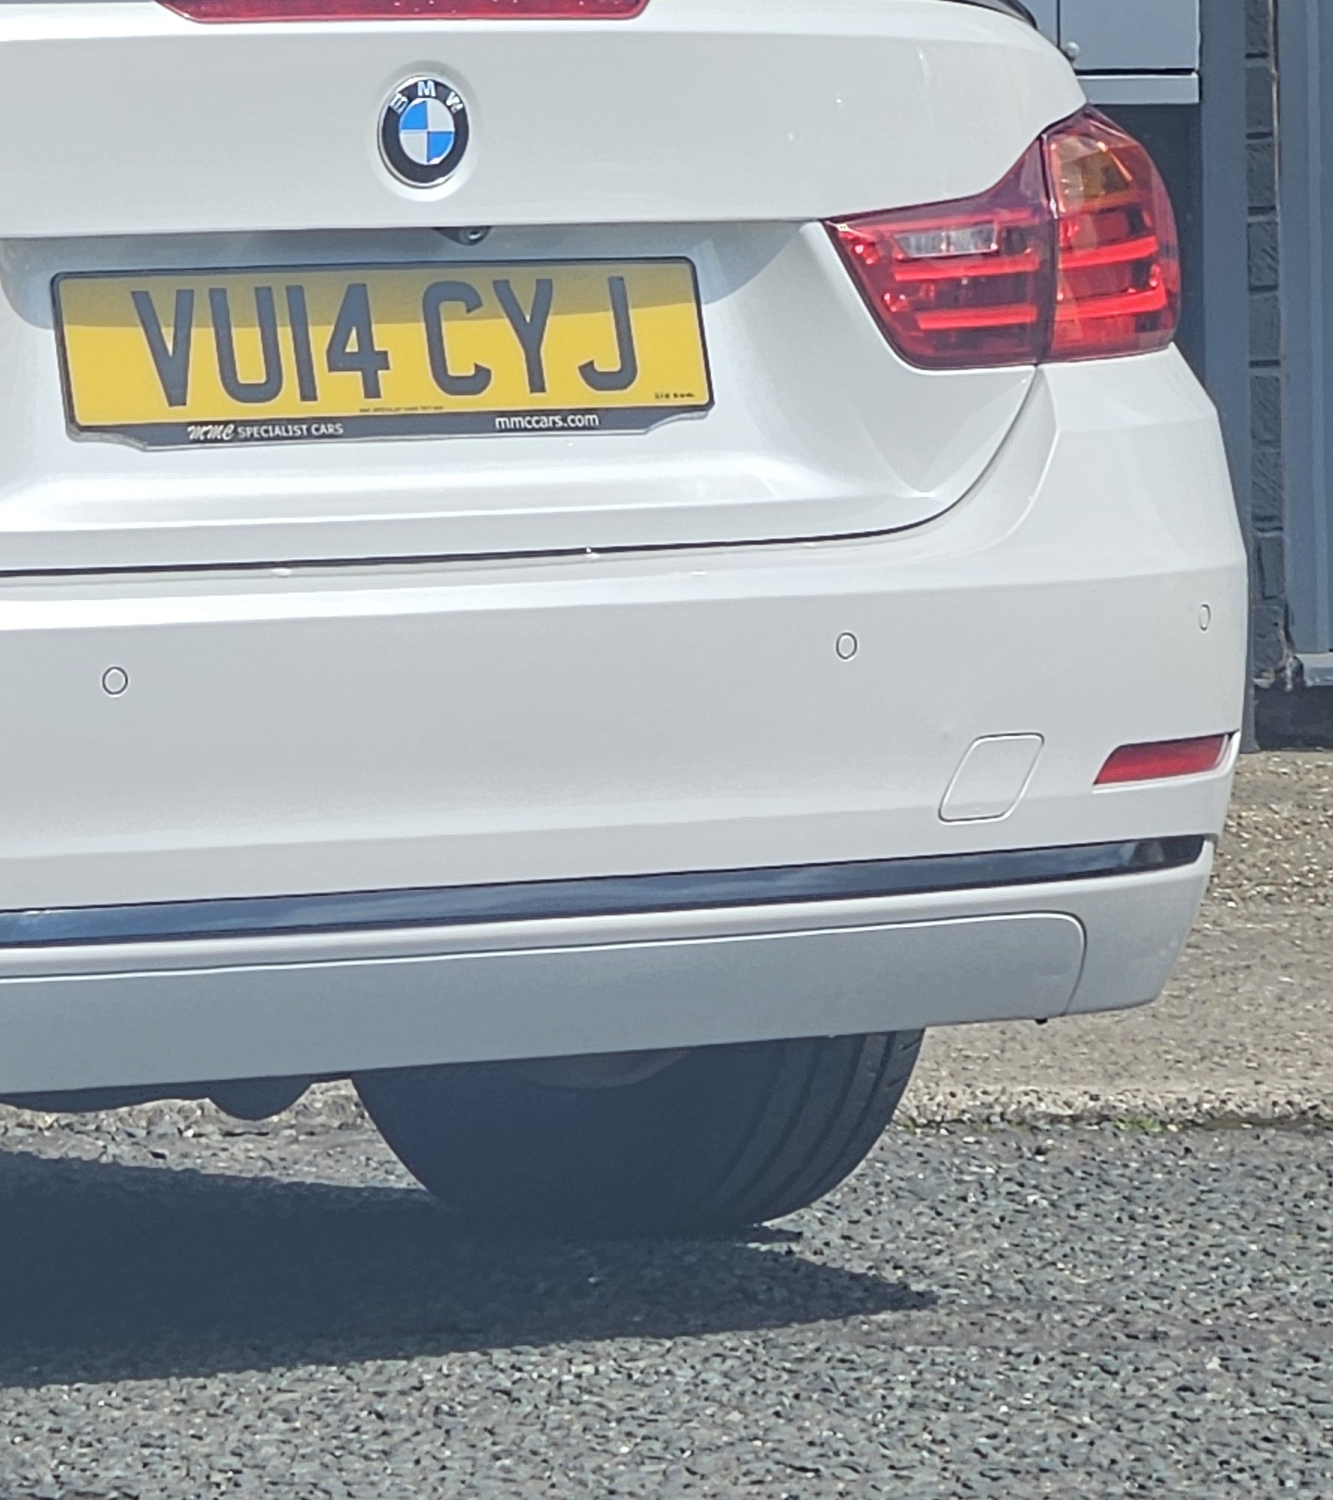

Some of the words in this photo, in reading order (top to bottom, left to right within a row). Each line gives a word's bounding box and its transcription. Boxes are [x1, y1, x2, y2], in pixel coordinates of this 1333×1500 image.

[389, 79, 464, 115] BMW
[130, 282, 391, 407] VU14
[421, 275, 639, 397] CYJ
[187, 423, 235, 441] MMC
[237, 424, 308, 439] SPECIALIST
[311, 422, 345, 437] CARS
[494, 411, 599, 431] mmccars.com
